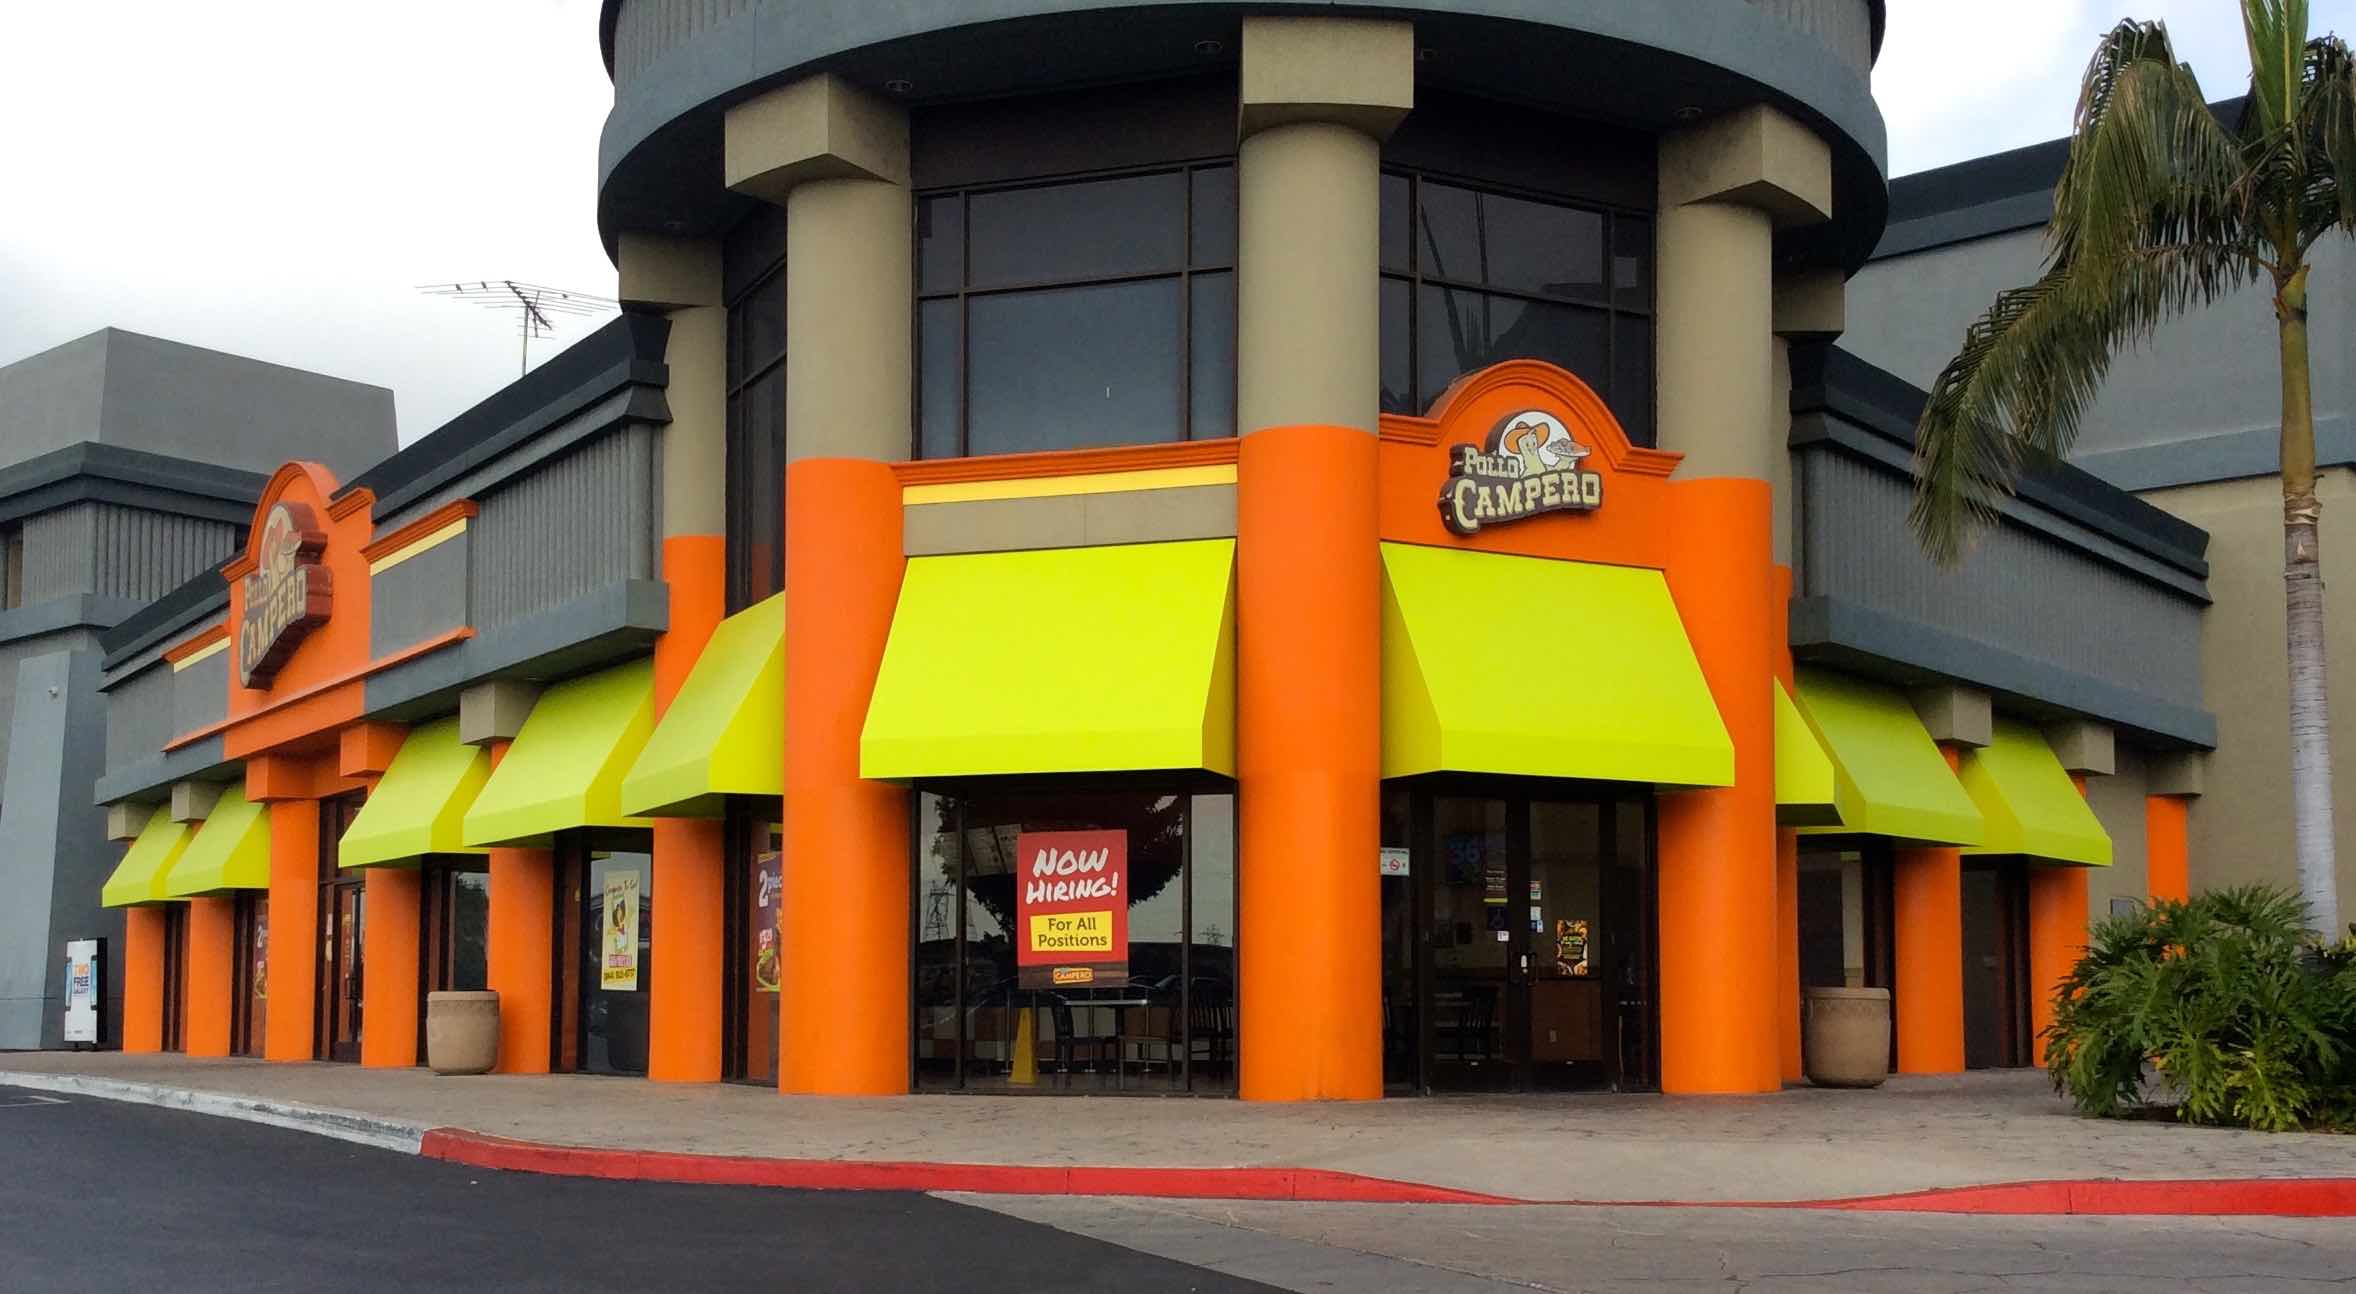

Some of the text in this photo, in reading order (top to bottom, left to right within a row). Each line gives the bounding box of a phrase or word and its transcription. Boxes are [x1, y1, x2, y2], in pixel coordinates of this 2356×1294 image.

[1454, 472, 1601, 530] CAMPERO
[241, 568, 306, 687] CAMPERO
[1032, 847, 1109, 878] NOW
[758, 869, 769, 908] 2
[1025, 871, 1119, 905] HIRING!
[1037, 933, 1108, 948] Positions
[1047, 917, 1097, 931] For All
